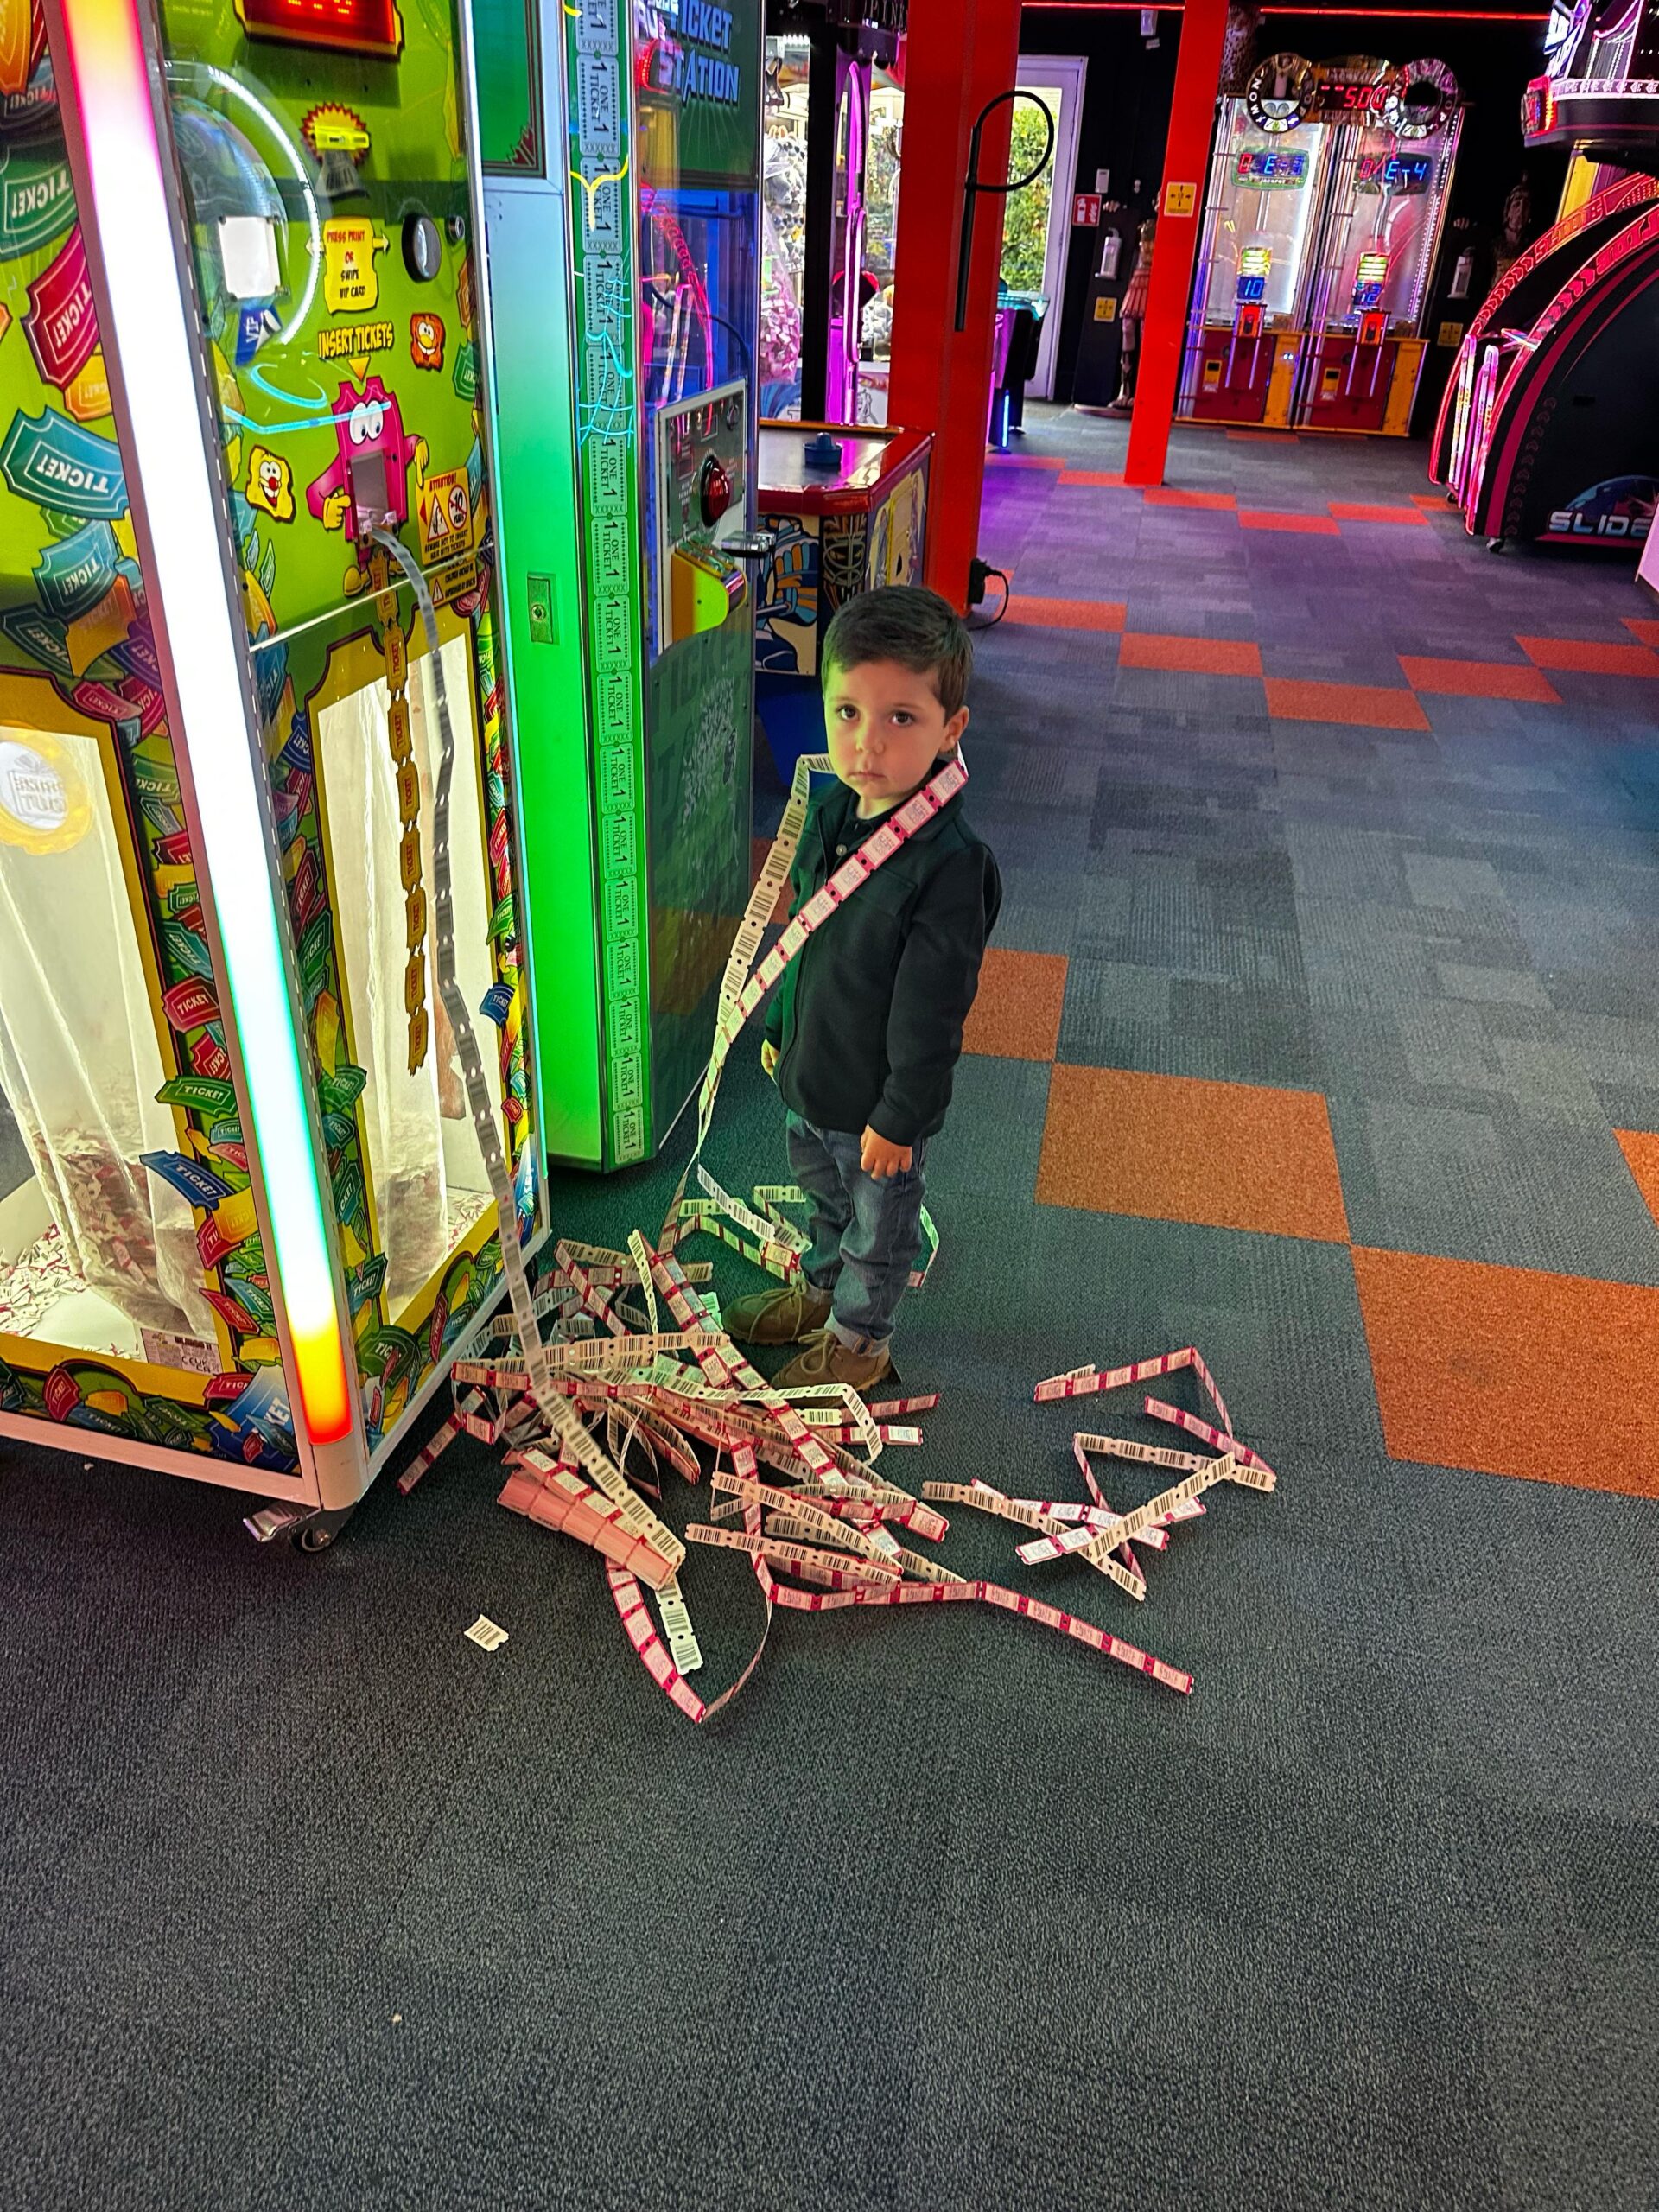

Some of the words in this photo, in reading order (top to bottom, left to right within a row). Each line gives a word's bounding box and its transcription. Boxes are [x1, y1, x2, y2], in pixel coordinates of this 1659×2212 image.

[590, 20, 607, 31] 1
[592, 61, 608, 72] 1
[659, 41, 740, 103] STATION
[590, 73, 600, 121] TICKET
[599, 84, 609, 113] ONE
[593, 124, 610, 134] 1
[594, 164, 611, 174] 1
[11, 168, 70, 218] TICKET
[601, 185, 612, 213] ONE
[595, 221, 613, 232] 1
[326, 231, 346, 244] PRESS
[347, 230, 366, 243] PRINT
[344, 251, 354, 263] OR
[597, 260, 613, 270] 1
[340, 269, 359, 281] SWIPE
[340, 287, 350, 299] VIP
[350, 285, 366, 298] CARD
[594, 270, 606, 315] TICKET
[1245, 279, 1264, 297] 10
[53, 281, 92, 348] TICKET
[598, 315, 614, 324] 1
[245, 315, 259, 344] VIP
[318, 329, 354, 358] INSERT
[355, 321, 394, 353] TICKETS
[607, 371, 616, 395] ONE
[601, 438, 617, 448] 1
[37, 454, 109, 493] TICKET
[600, 448, 611, 489] TICKET
[608, 456, 618, 480] ONE
[603, 488, 619, 498] 1
[604, 521, 619, 530] 1
[1548, 511, 1654, 537] SLIDE
[602, 532, 613, 569] TICKET
[610, 538, 620, 562] ONE
[62, 556, 101, 597] TICKET
[605, 569, 620, 578] 1
[606, 600, 620, 609] 1
[605, 609, 615, 647] TICKET
[613, 617, 622, 639] ONE
[391, 642, 401, 676] TICKET
[607, 645, 622, 655] 1
[608, 676, 623, 684] 1
[607, 684, 617, 721] TICKET
[615, 691, 624, 713] ONE
[395, 714, 404, 747] TICKET
[610, 719, 625, 728] 1
[611, 747, 625, 756] 1
[609, 757, 619, 790] TICKET
[617, 762, 626, 782] ONE
[613, 788, 626, 798] 1
[613, 815, 626, 824] 1
[612, 824, 621, 857] TICKET
[620, 830, 628, 849] ONE
[614, 855, 628, 864] 1
[615, 880, 629, 888] 1
[614, 888, 624, 921] TICKET
[621, 893, 630, 912] ONE
[616, 918, 630, 926] 1
[617, 942, 631, 950] 1
[616, 949, 626, 981] TICKET
[623, 954, 632, 972] ONE
[619, 977, 632, 986] 1
[176, 992, 210, 1016] TICKET
[493, 994, 510, 1009] TICKET
[620, 1001, 632, 1009] 1
[618, 1007, 627, 1039] TICKET
[620, 1034, 633, 1043] 1
[621, 1057, 634, 1065] 1
[620, 1064, 629, 1094] TICKET
[626, 1068, 635, 1085] ONE
[184, 1085, 224, 1101] TICKET
[622, 1090, 635, 1098] 1
[623, 1110, 635, 1120] 1
[621, 1118, 631, 1149] TICKET
[624, 1142, 637, 1151] 1
[175, 1165, 218, 1197] TICKET
[353, 1273, 376, 1299] TICKET
